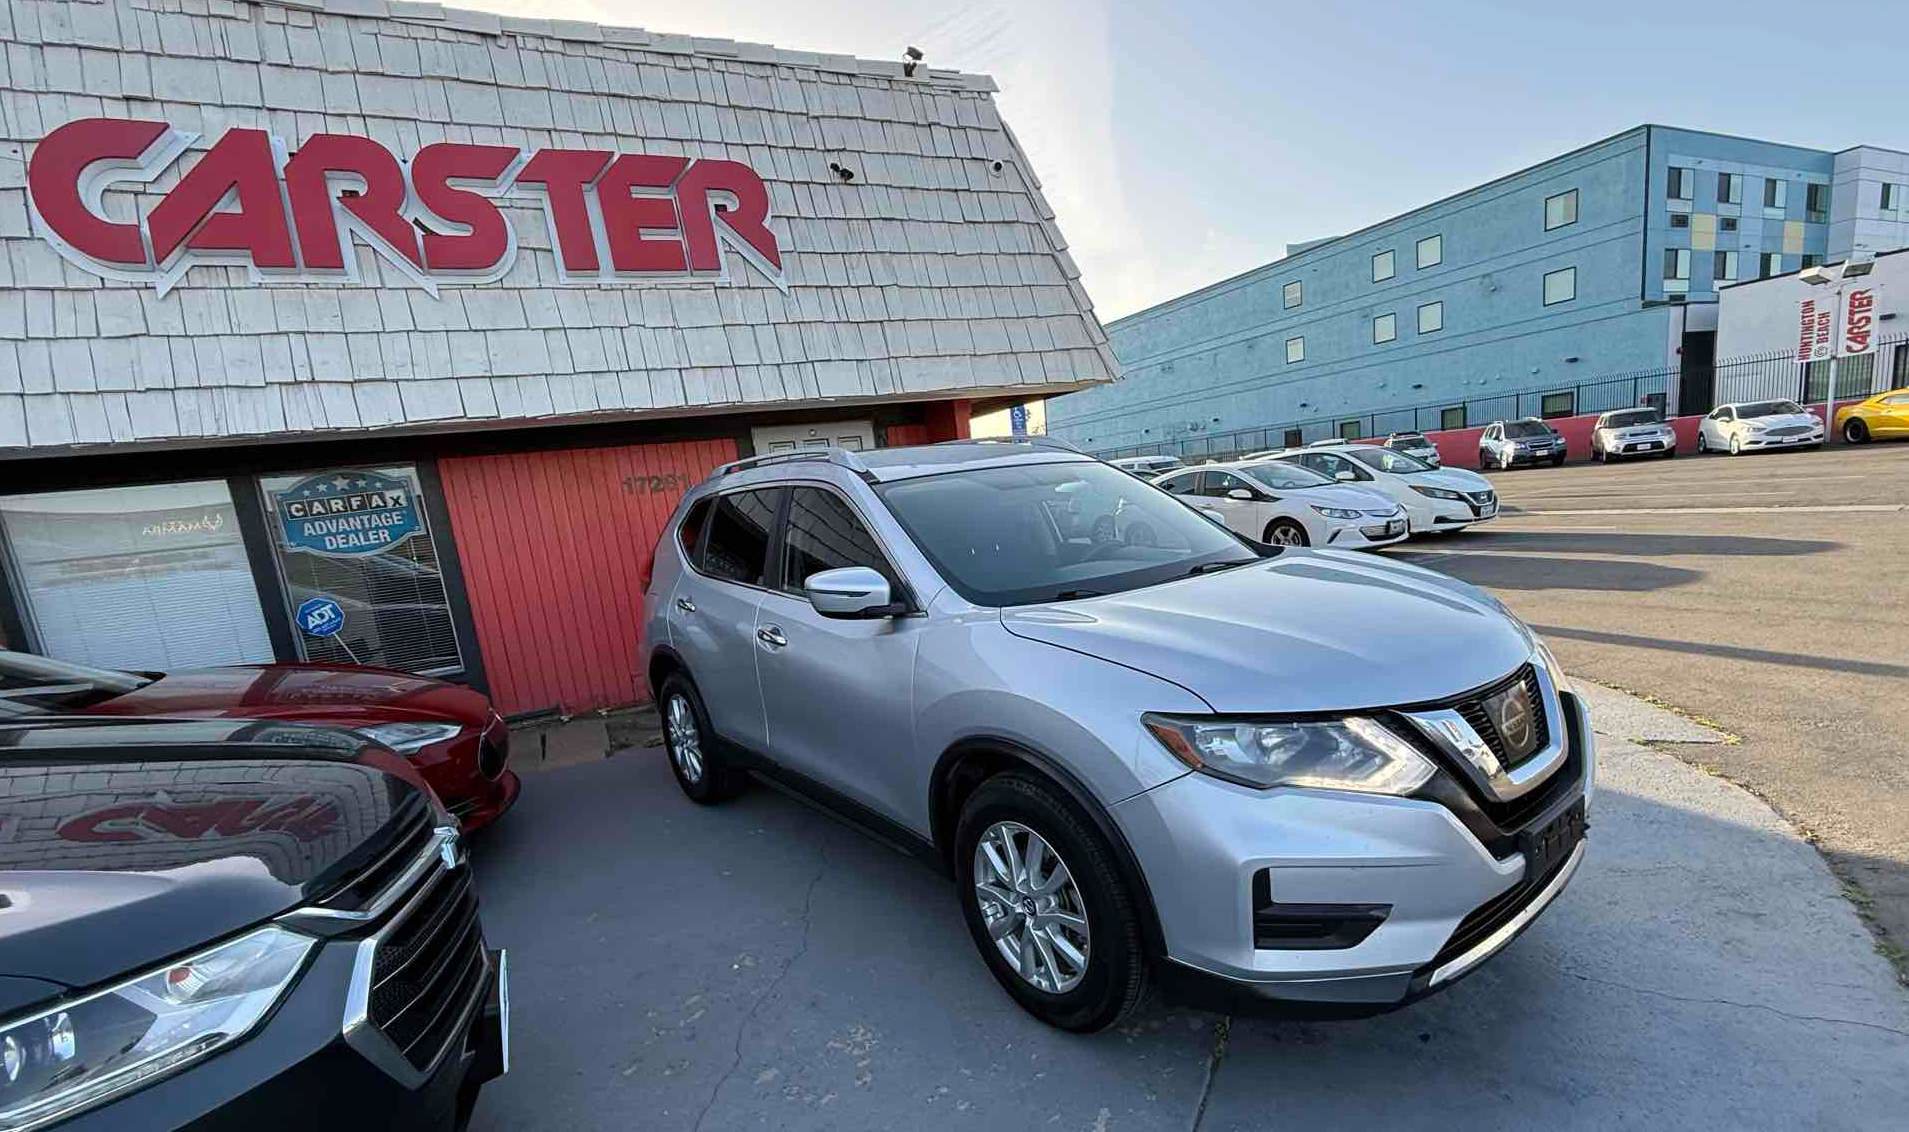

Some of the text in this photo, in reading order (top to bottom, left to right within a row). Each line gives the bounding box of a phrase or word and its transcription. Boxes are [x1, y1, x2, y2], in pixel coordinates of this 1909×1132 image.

[28, 118, 784, 285] CARSTER
[1798, 299, 1815, 361] HUNTINGTON
[1816, 311, 1831, 345] BEACH
[1846, 288, 1873, 354] CARSTER
[288, 493, 405, 518] CARFAX
[303, 510, 404, 537] ADVANTAGE
[324, 529, 391, 550] DEALER
[307, 603, 336, 630] ADT
